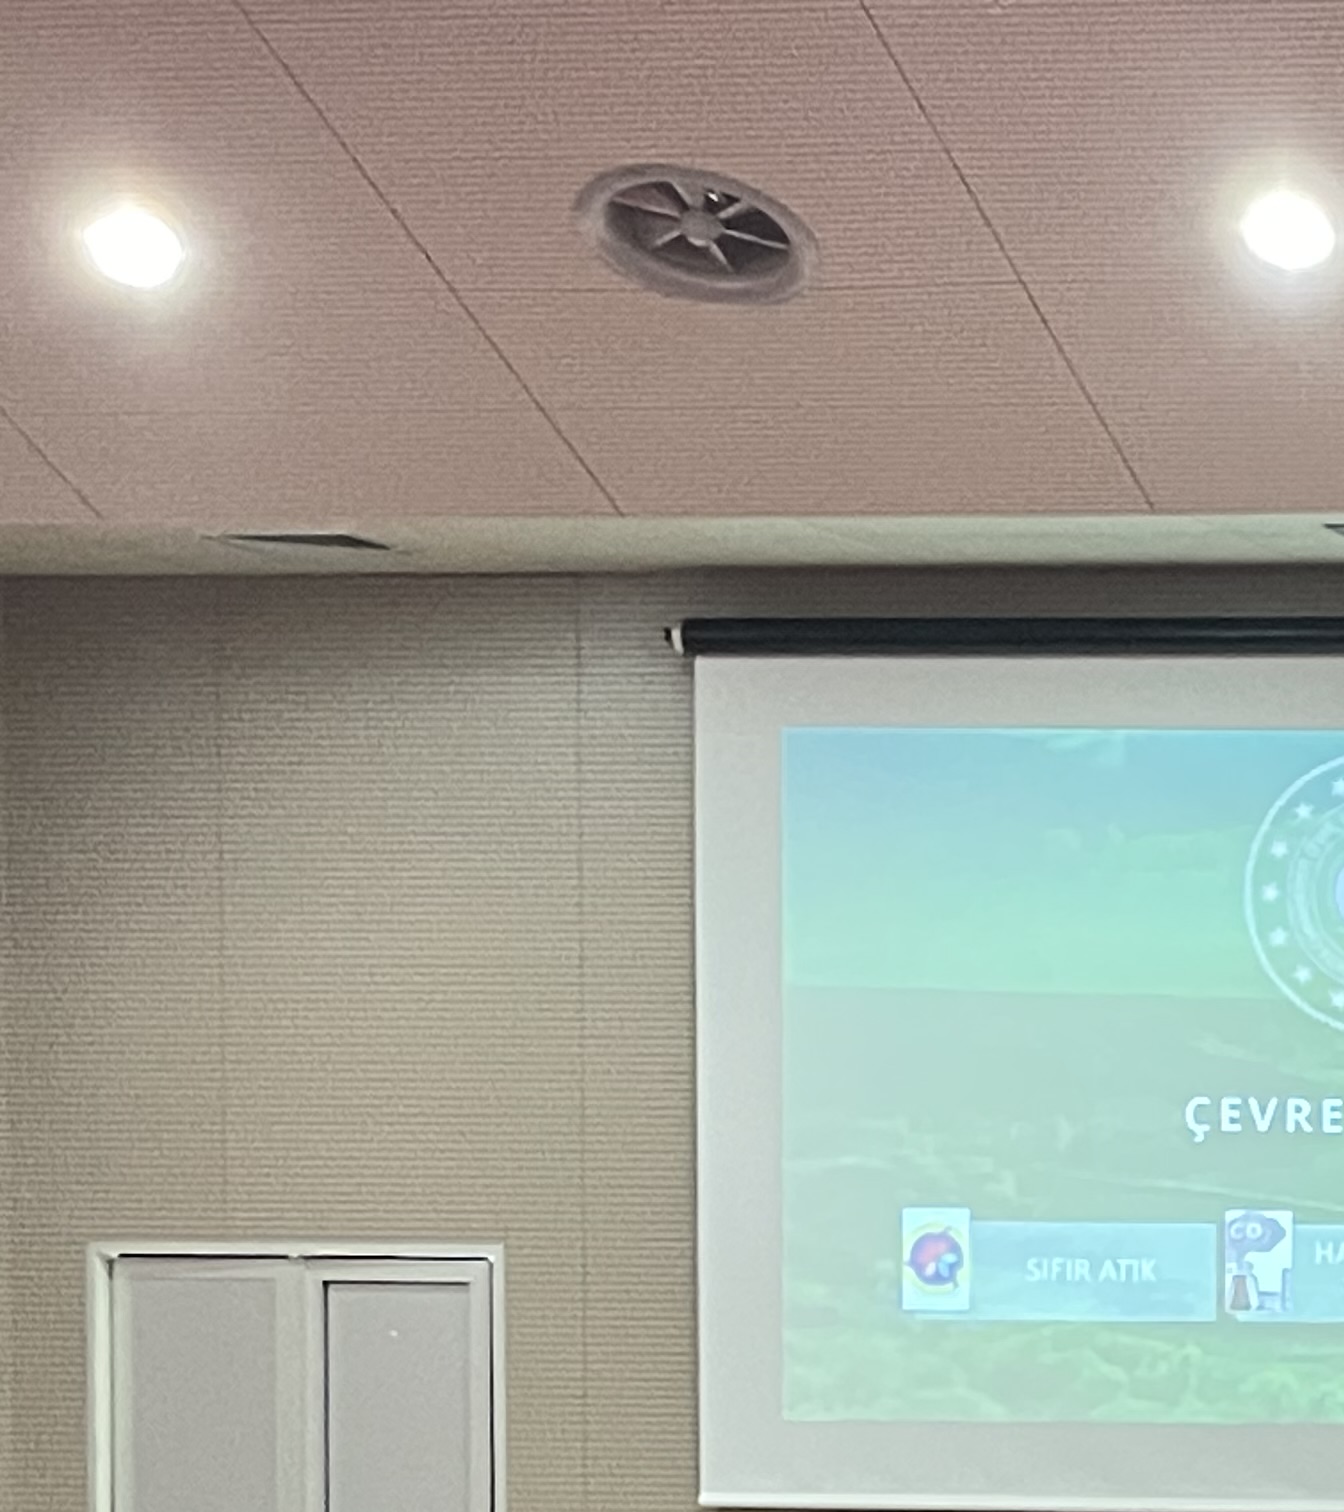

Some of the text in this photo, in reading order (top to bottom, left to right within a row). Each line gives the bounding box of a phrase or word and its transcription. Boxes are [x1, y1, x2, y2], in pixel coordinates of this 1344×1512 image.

[1184, 1095, 1344, 1143] ÇEVRE
[1025, 1256, 1158, 1283] SIFIR ATIK
